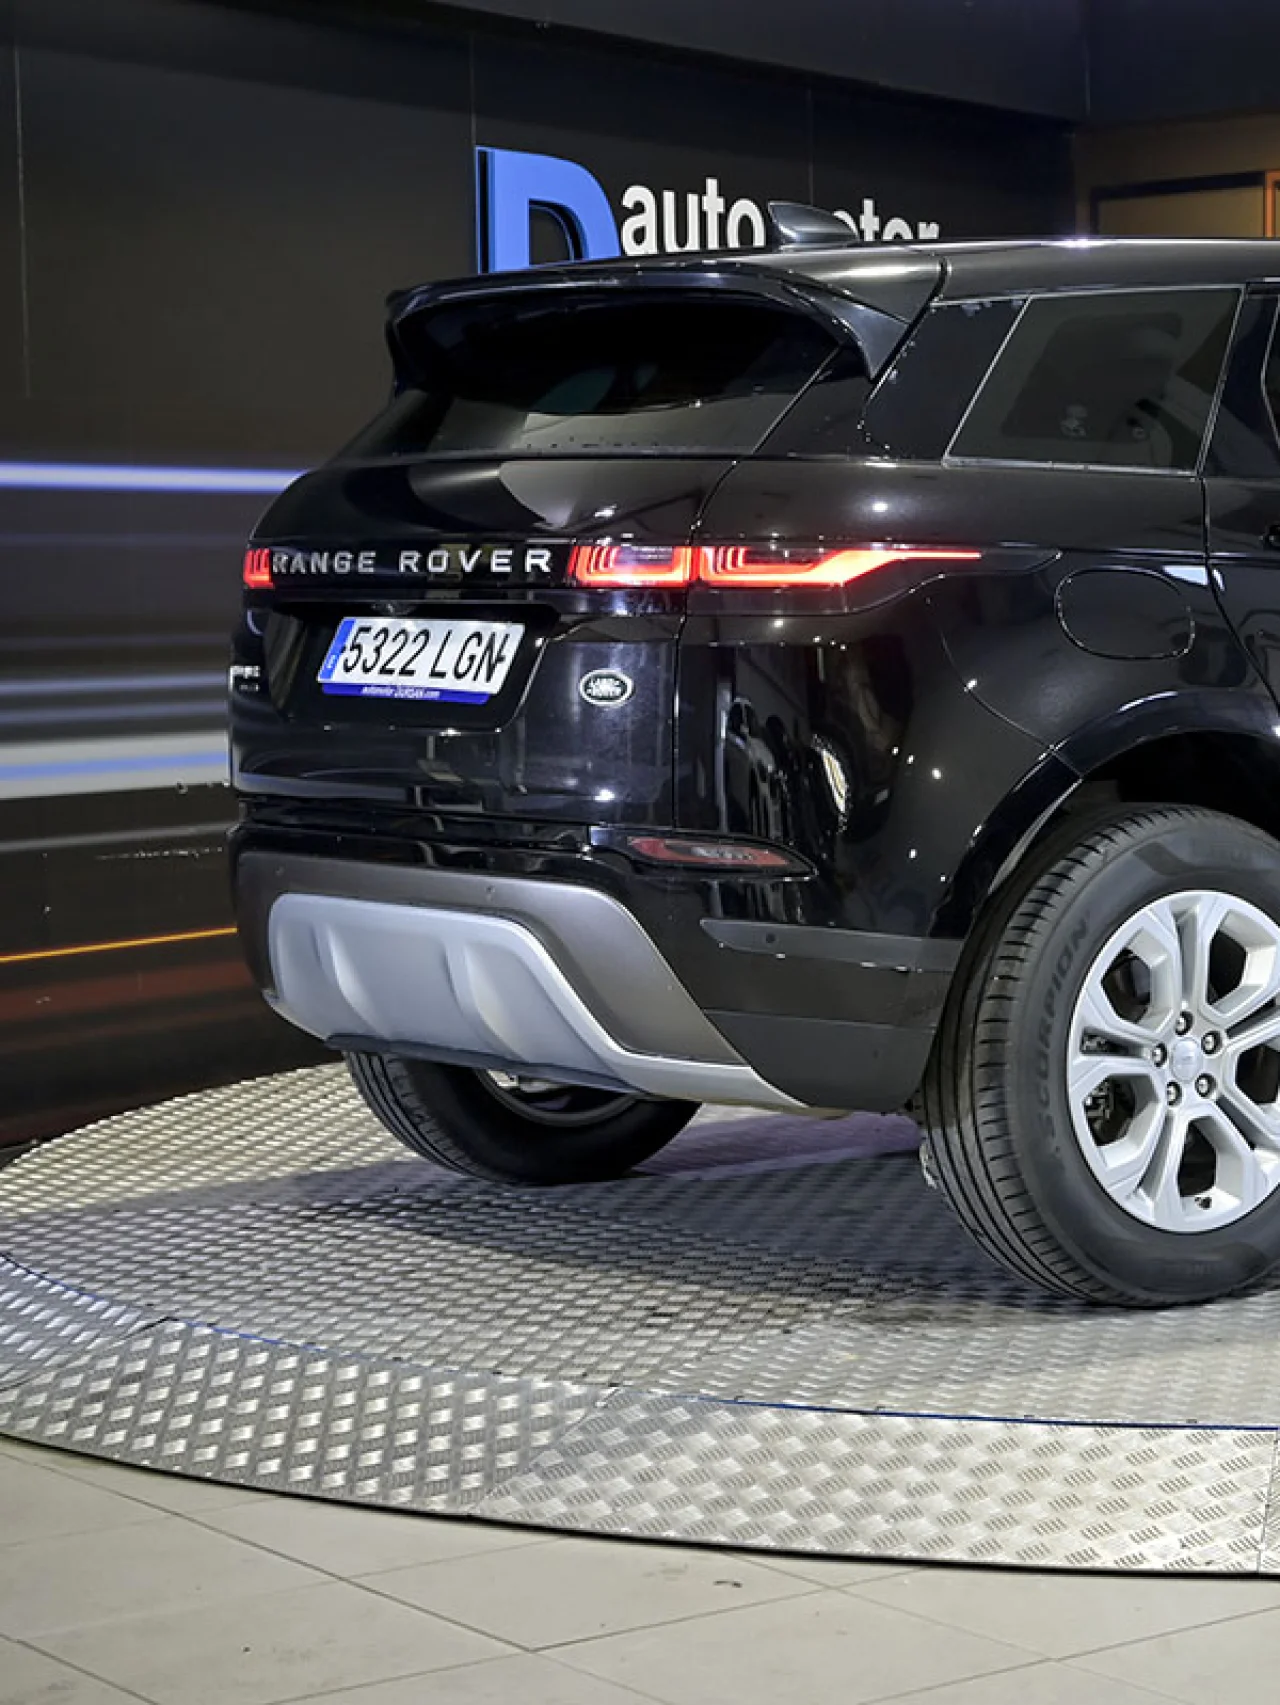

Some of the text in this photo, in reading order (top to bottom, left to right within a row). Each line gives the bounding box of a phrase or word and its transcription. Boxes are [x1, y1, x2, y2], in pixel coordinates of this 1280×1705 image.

[621, 177, 940, 254] autot
[273, 549, 551, 574] RANGE ROVER
[343, 626, 510, 684] 5322 LGN
